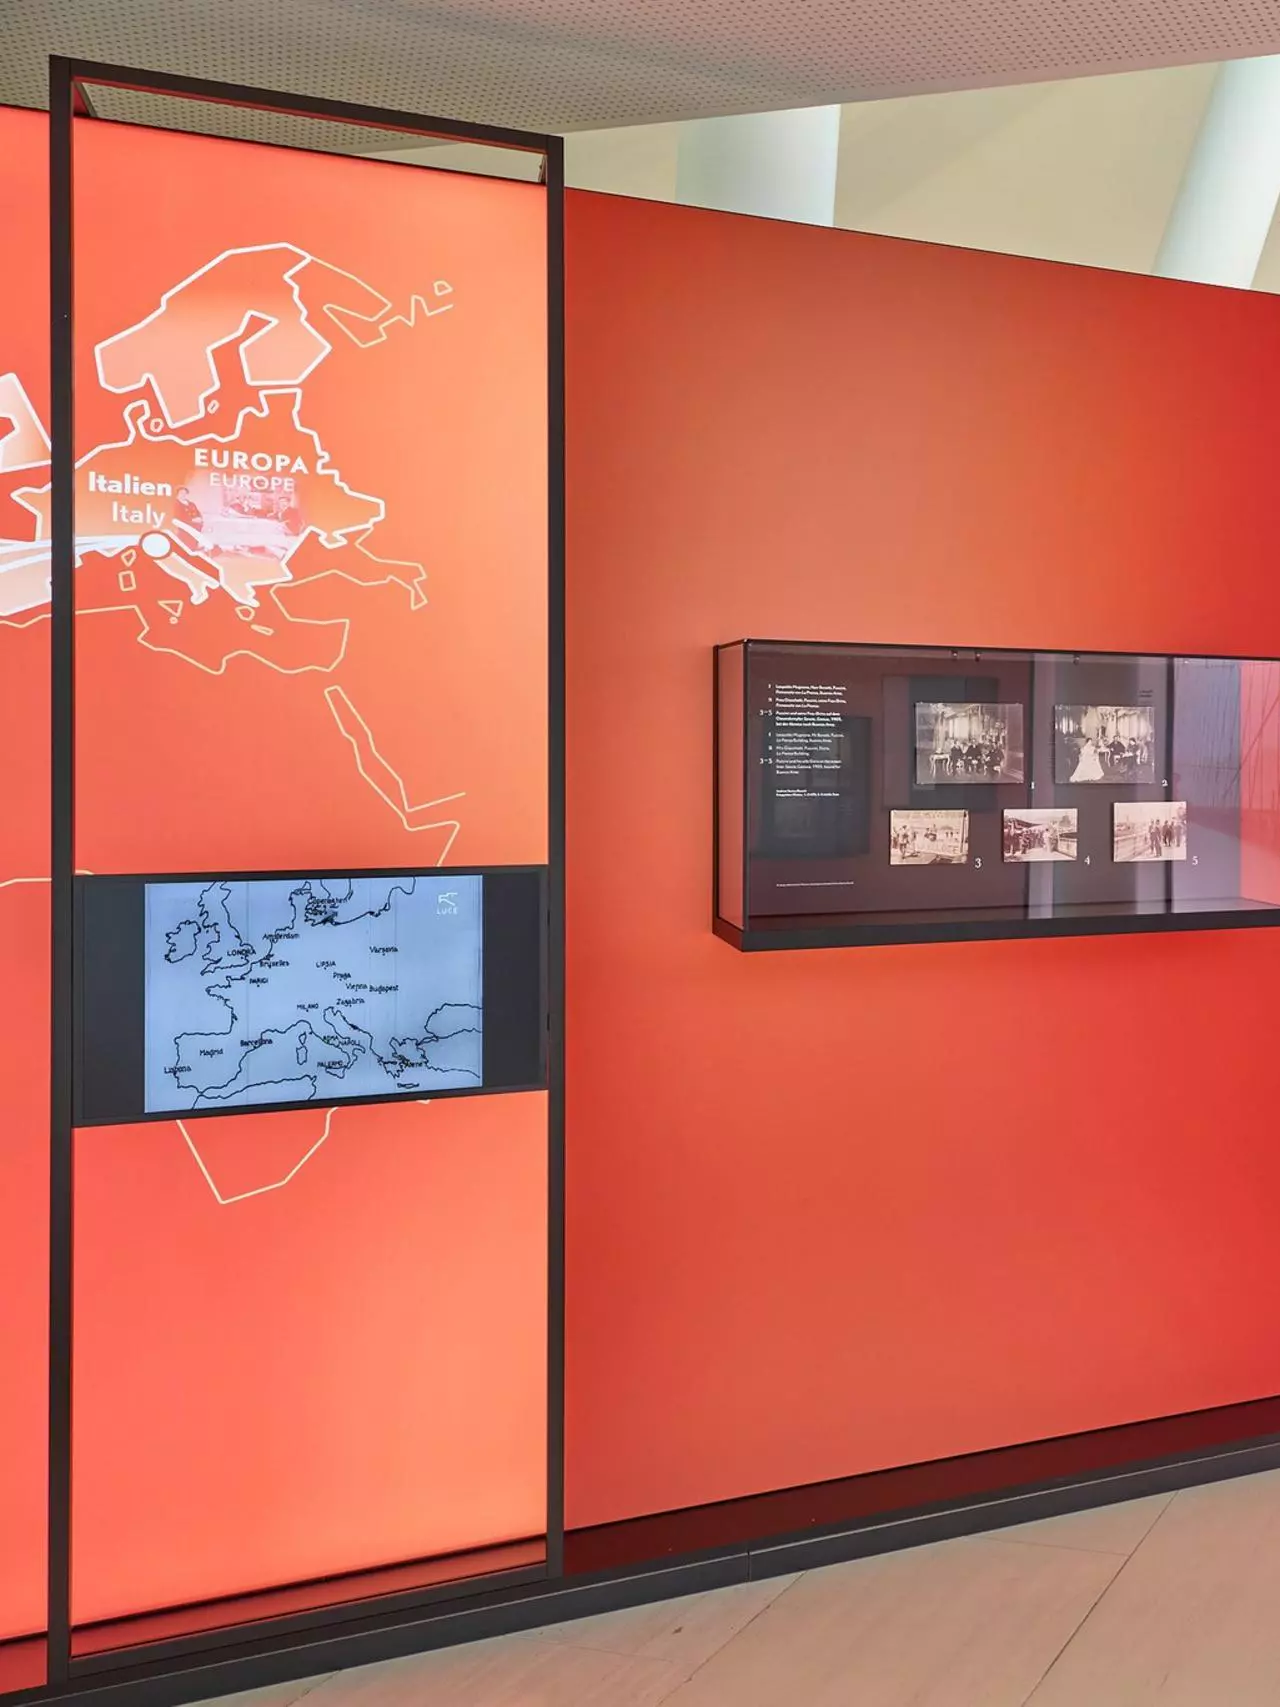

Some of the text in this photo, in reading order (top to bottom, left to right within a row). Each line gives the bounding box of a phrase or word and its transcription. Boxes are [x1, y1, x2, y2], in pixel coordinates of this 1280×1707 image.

[194, 448, 309, 474] EUROPA
[88, 471, 172, 497] Italien
[209, 472, 295, 492] EUROPE
[112, 501, 166, 528] Italy
[974, 857, 983, 869] 3
[1083, 855, 1091, 866] 4
[1191, 854, 1199, 865] 5
[437, 907, 458, 916] LUCE
